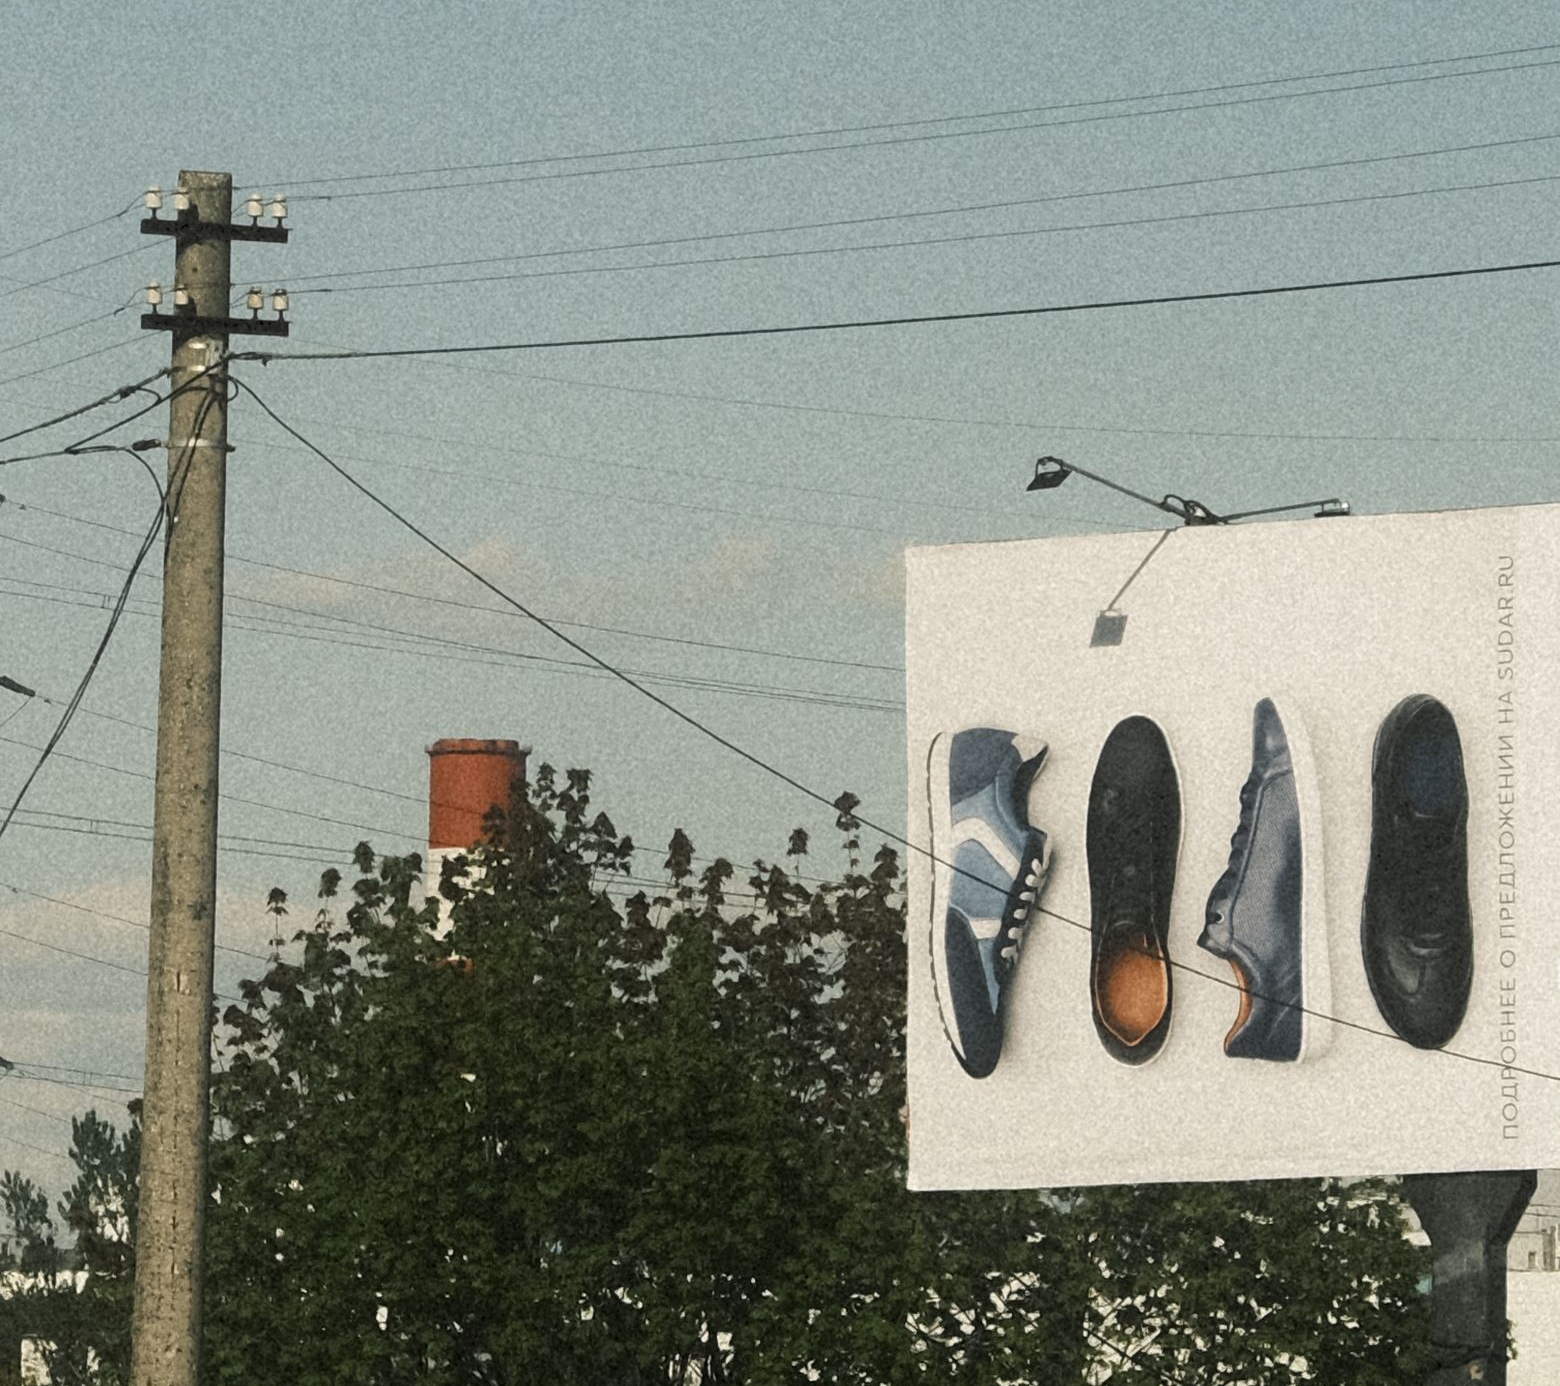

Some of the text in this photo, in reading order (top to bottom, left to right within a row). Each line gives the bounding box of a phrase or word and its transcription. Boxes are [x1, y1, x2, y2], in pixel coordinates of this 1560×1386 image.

[1497, 554, 1519, 1140] ПОДРОБНЕЕ О ПРЕДЛОЖЕНИИ НА SUDAR.RU
